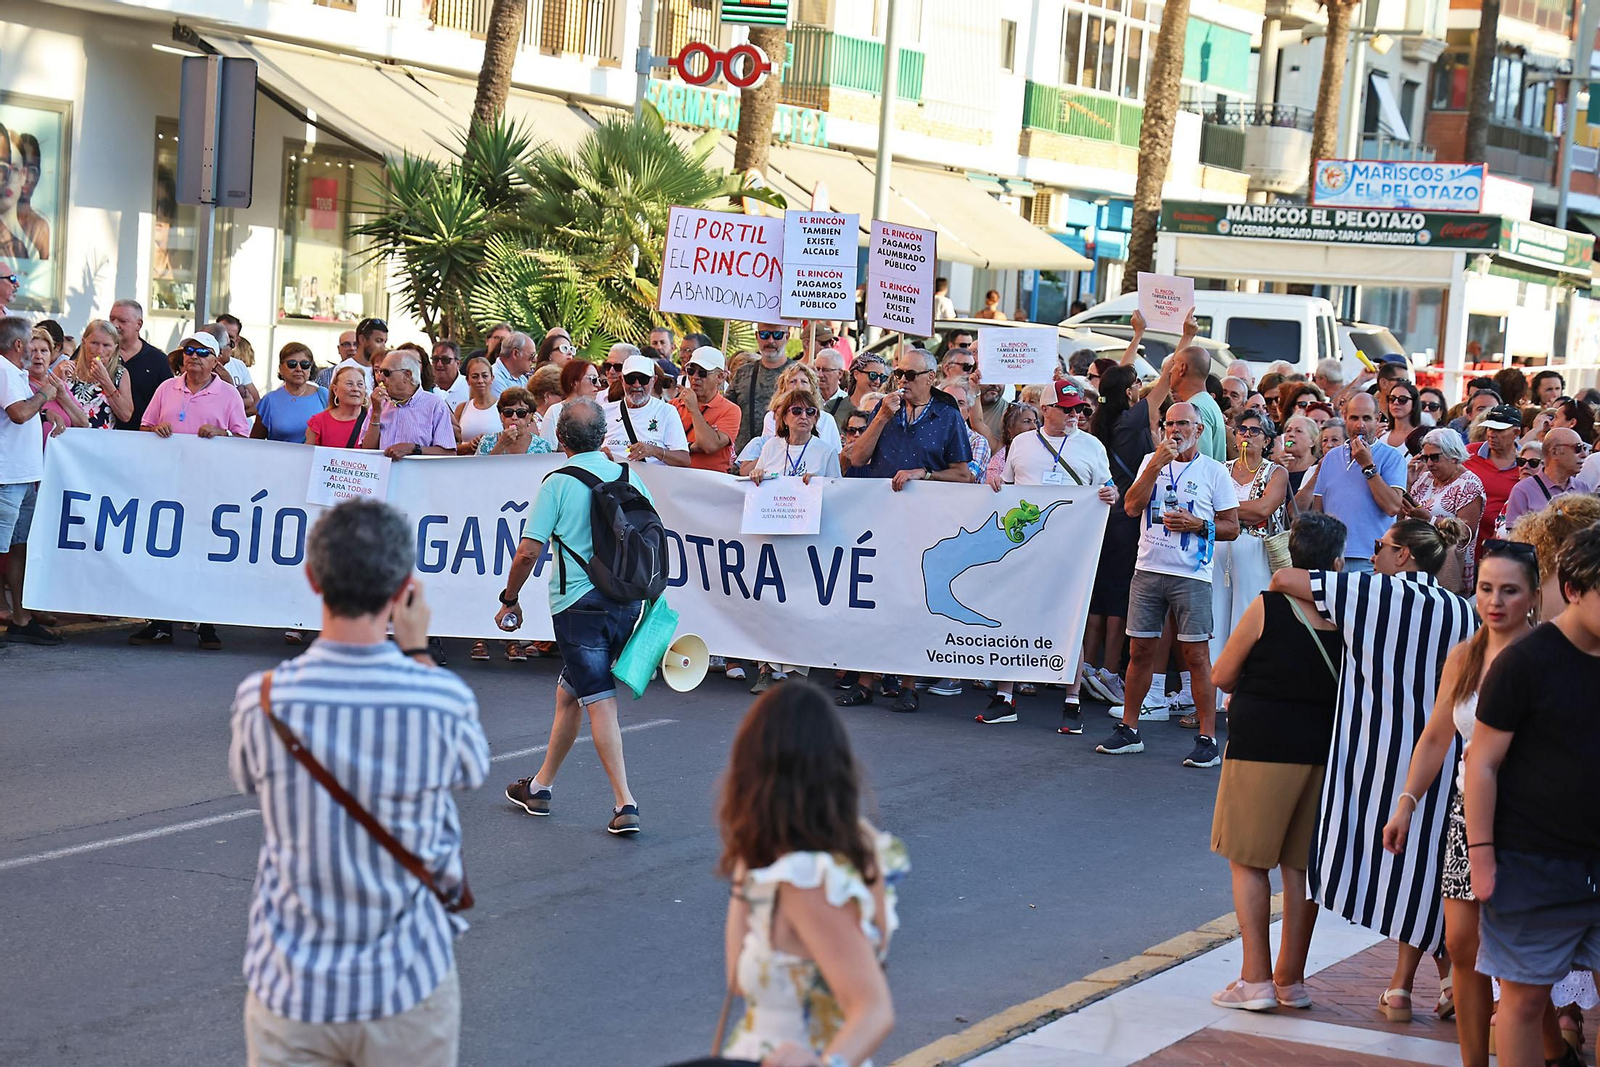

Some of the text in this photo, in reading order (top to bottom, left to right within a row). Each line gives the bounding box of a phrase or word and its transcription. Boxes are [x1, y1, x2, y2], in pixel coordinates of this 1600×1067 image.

[777, 106, 829, 148] TICA
[1352, 164, 1443, 181] MARISCOS
[1356, 183, 1478, 200] EL PELOTAZO
[316, 197, 333, 210] TOUS
[810, 216, 846, 225] RINCÓN
[1226, 205, 1426, 230] MARISCOS EL PELOTAZO
[674, 215, 767, 244] EL PORTIL
[803, 227, 841, 235] TAMBIEN
[882, 228, 922, 241] EL RINCÓN
[882, 238, 921, 252] PAGAMOS
[803, 248, 839, 256] ALCALDE
[877, 247, 926, 263] ALUMBRADO
[670, 247, 782, 282] EL RINCON
[885, 258, 917, 272] PÚBLICO
[808, 269, 843, 278] RINCÓN
[796, 280, 842, 289] PAGAMOS
[889, 282, 920, 295] RINCÓN
[791, 290, 847, 299] ALUMBRADO
[883, 291, 916, 304] TAMBIEN
[800, 299, 837, 309] PÚBLICO
[883, 312, 915, 324] ALCALDE
[58, 490, 184, 558] EMO
[207, 488, 308, 566] SÍO
[664, 528, 786, 603] OTRA
[807, 530, 877, 609] VÉ
[945, 633, 1053, 649] Asociación de
[926, 649, 1065, 671] Vecinos Portileñ@
